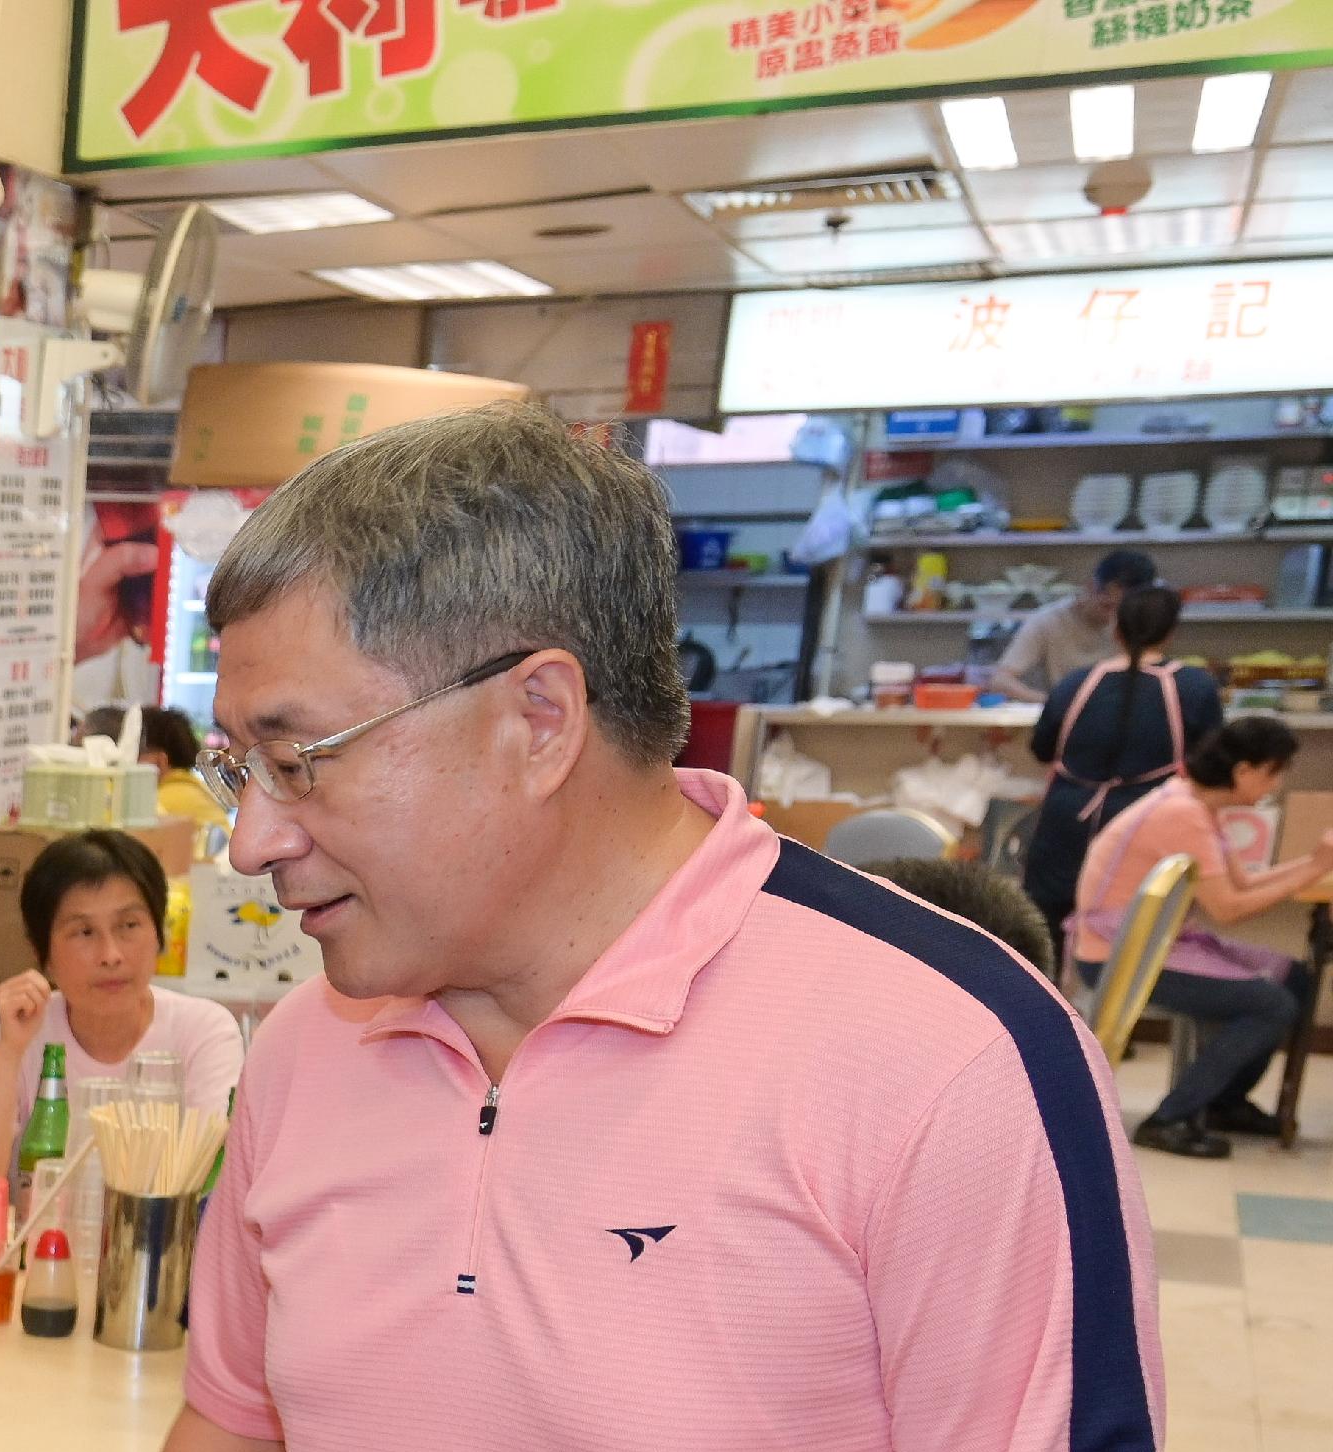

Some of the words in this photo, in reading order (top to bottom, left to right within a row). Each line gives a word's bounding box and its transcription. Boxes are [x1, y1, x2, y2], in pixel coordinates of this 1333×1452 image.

[756, 26, 901, 80] 原盅蒸飯
[948, 281, 1272, 354] 波仔記
